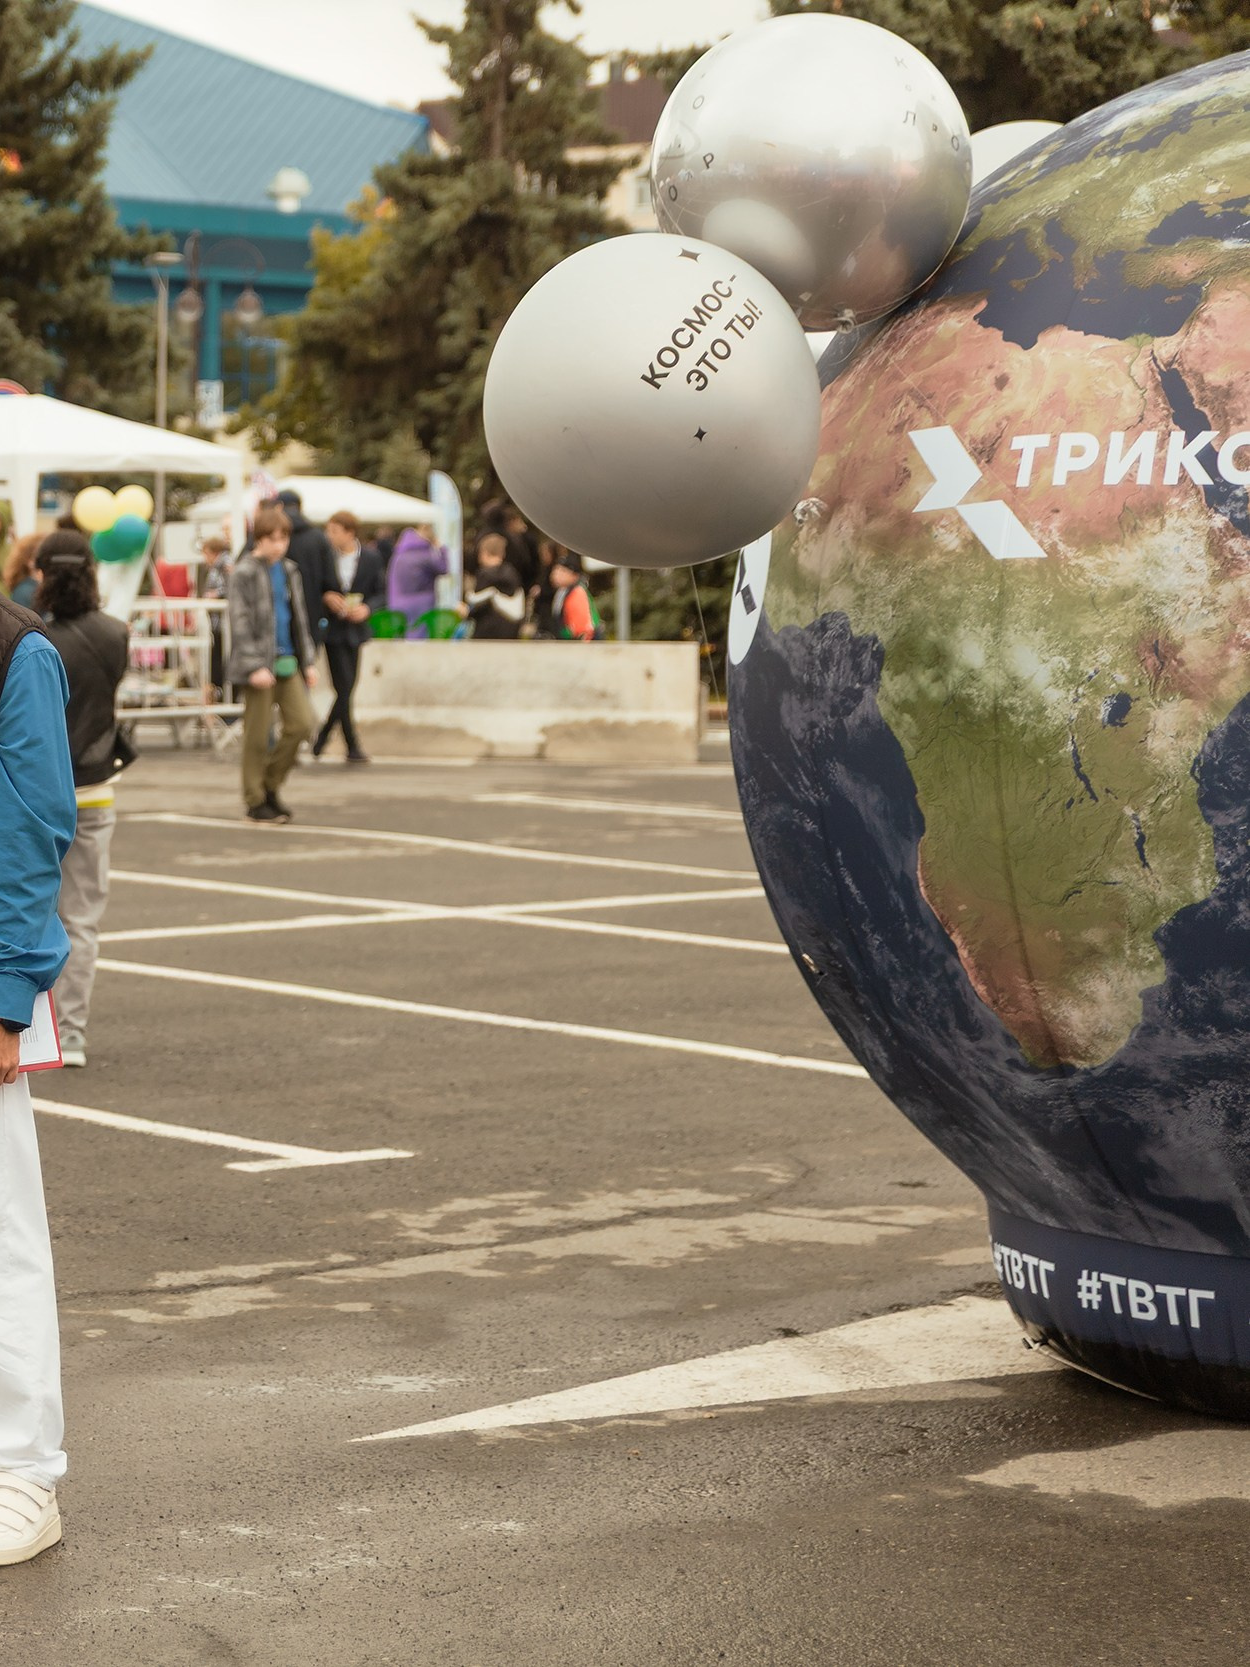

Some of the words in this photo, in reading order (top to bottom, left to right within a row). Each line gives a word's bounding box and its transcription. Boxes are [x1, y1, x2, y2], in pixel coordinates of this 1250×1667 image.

[640, 274, 737, 390] КОСМОС-
[686, 338, 732, 391] ЭТО
[723, 297, 763, 340] ТЫ!
[1077, 1269, 1216, 1329] #ТВТГ
